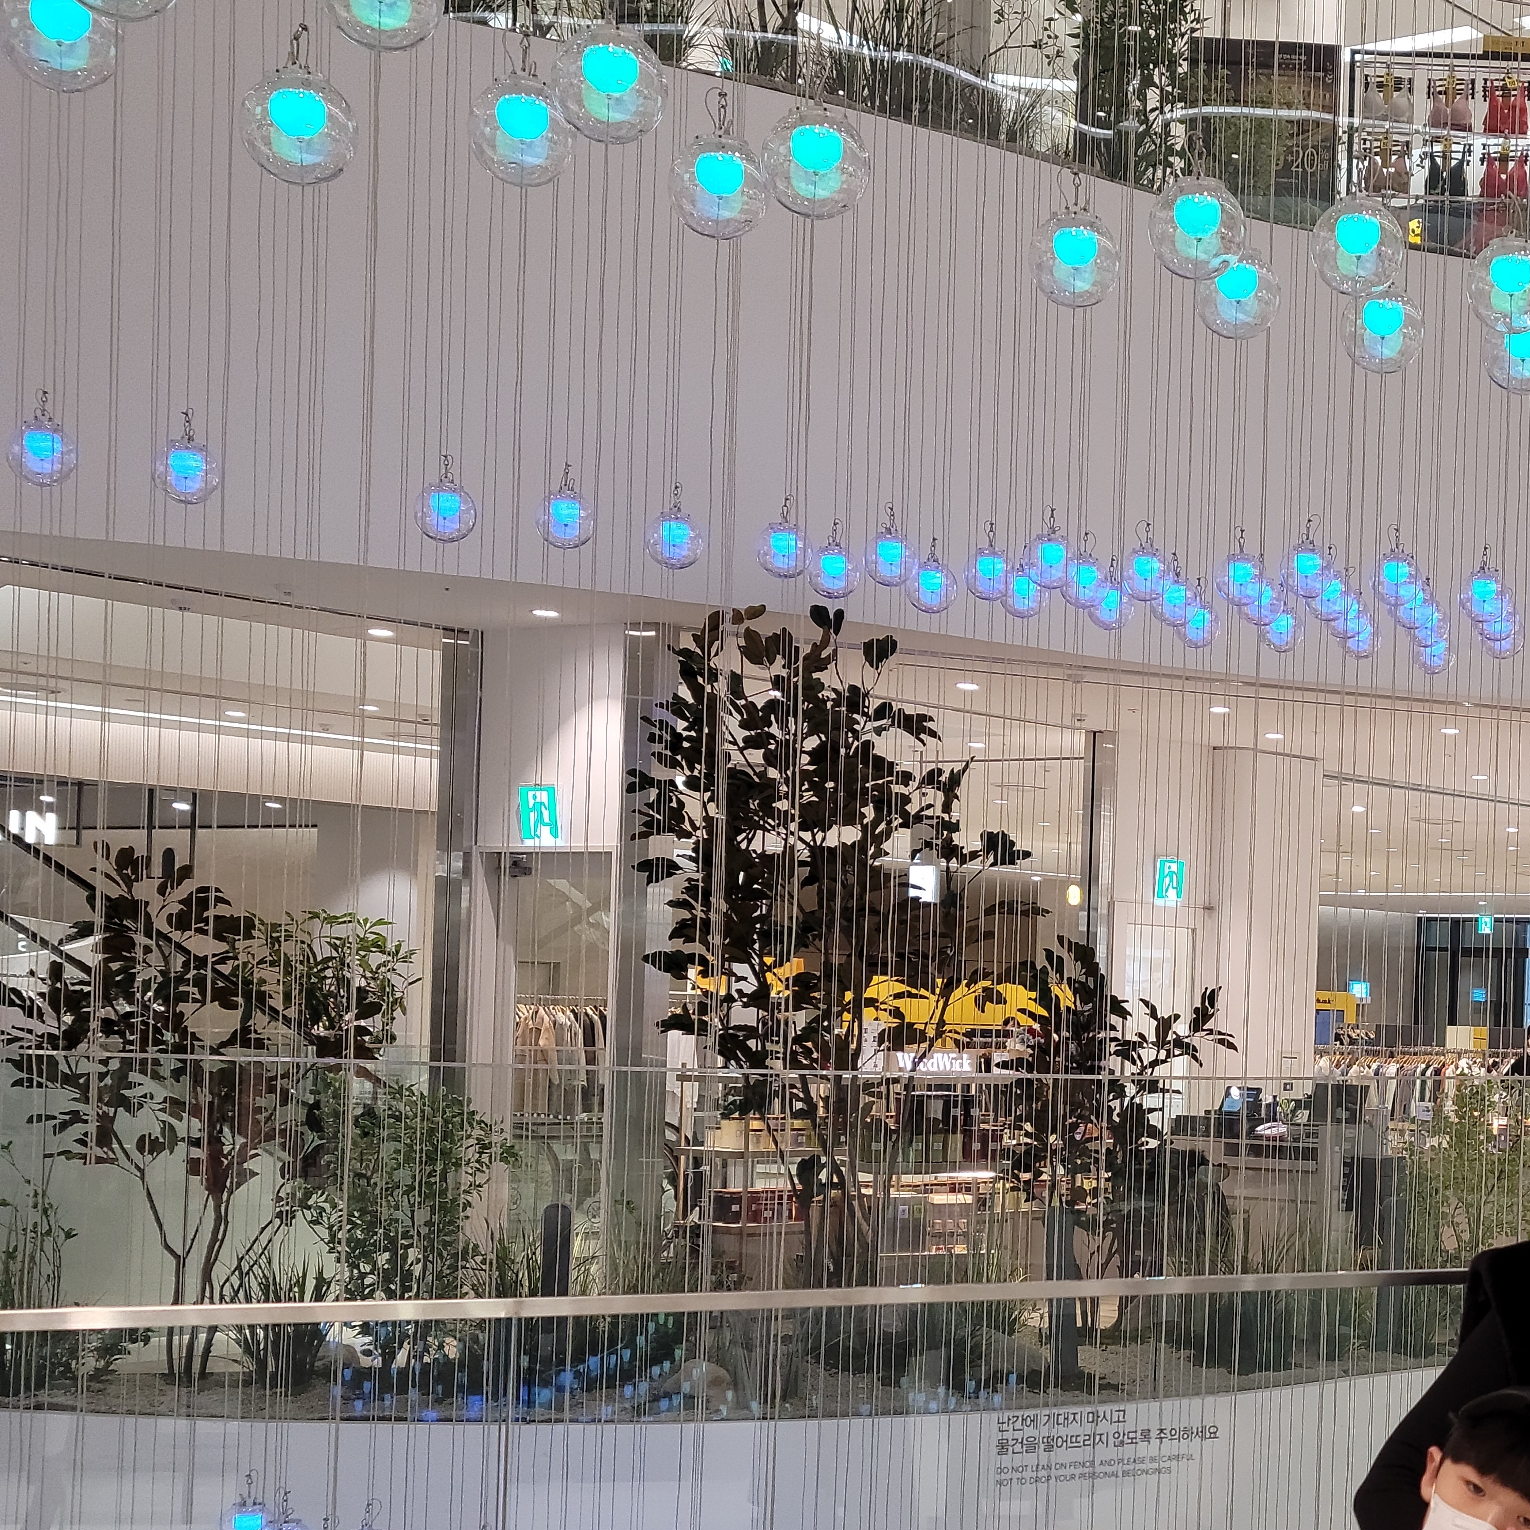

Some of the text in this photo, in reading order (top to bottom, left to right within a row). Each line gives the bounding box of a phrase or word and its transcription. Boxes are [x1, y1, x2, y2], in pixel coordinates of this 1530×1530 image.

[8, 809, 56, 845] IN
[896, 1051, 972, 1072] WodWick
[997, 1407, 1127, 1433] 난간에 기대지 마시고
[996, 1424, 1220, 1456] 물건을 떨어뜨리지 않도록 주의하세요
[995, 1466, 1172, 1487] NOT TO DROP YOUR PERSONAL BELONGINGS
[996, 1466, 1010, 1476] DO
[1011, 1464, 1029, 1474] NOT
[1031, 1463, 1052, 1473] LEAN
[1054, 1462, 1067, 1471] ON
[1099, 1458, 1116, 1467] AND
[1117, 1456, 1146, 1466] PLEASE
[1148, 1455, 1159, 1464] BE
[1161, 1453, 1195, 1463] CAREFUL
